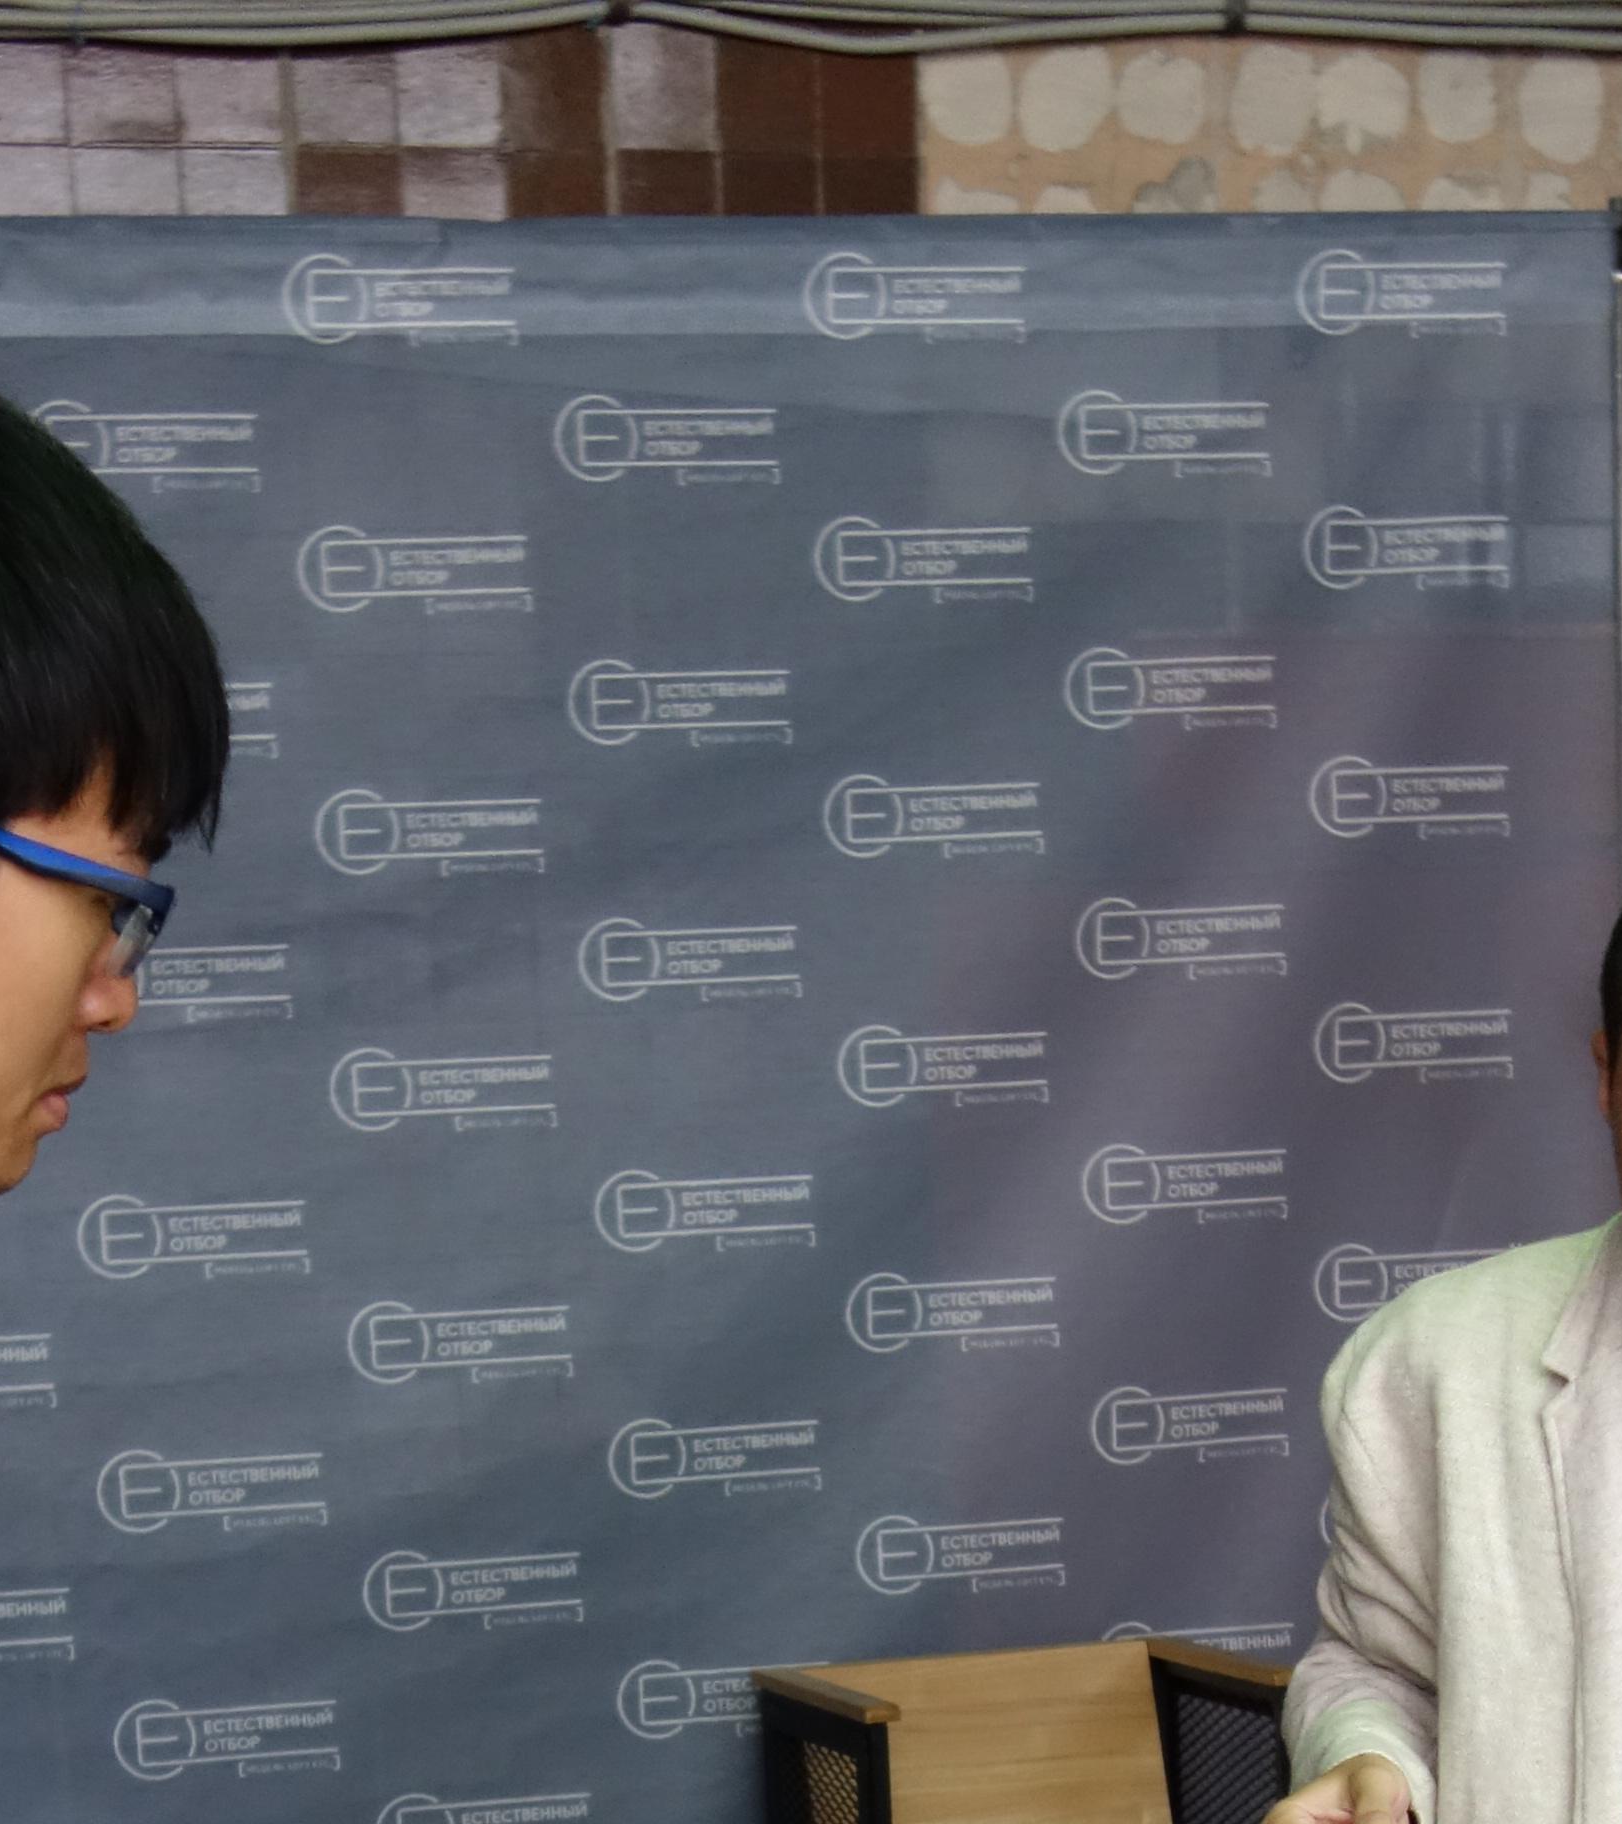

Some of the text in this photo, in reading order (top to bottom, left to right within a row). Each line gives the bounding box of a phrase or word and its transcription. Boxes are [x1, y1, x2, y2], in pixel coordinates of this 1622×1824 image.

[1151, 663, 1272, 685] ЕСТЕСТВЕННЫЙ
[658, 678, 785, 700] ЕСТЕСТВЕННЫЙ
[1151, 689, 1205, 704] ОТБОР
[658, 703, 714, 719] ОТБОР
[1391, 773, 1505, 794] ЕСТЕСТВЕННЫЙ
[911, 790, 1036, 813] ЕСТЕСТВЕННЫЙ
[1391, 798, 1442, 812] ОТБОР
[407, 807, 537, 829] ЕСТЕСТВЕННЫЙ
[912, 816, 967, 832] ОТБОР
[408, 833, 465, 848] ОТБОР
[1158, 912, 1279, 935] ЕСТЕСТВЕННЫЙ
[667, 933, 794, 956] ЕСТЕСТВЕННЫЙ
[1159, 938, 1212, 953] ОТБОР
[150, 953, 284, 976] ЕСТЕСТВЕННЫЙ
[668, 959, 724, 975] ОТБОР
[151, 980, 210, 996] ОТБОР
[1393, 1017, 1507, 1040] ЕСТЕСТВЕННЫЙ
[923, 1040, 1044, 1063] ЕСТЕСТВЕННЫЙ
[1393, 1042, 1443, 1057] ОТБОР
[420, 1063, 549, 1086] ЕСТЕСТВЕННЫЙ
[924, 1065, 977, 1081] ОТБОР
[421, 1089, 478, 1105] ОТБОР
[1166, 1157, 1284, 1180] ЕСТЕСТВЕННЫЙ
[683, 1183, 808, 1207] ЕСТЕСТВЕННЫЙ
[1166, 1183, 1218, 1198] ОТБОР
[170, 1209, 301, 1233] ЕСТЕСТВЕННЫЙ
[684, 1209, 739, 1226] ОТБОР
[171, 1236, 229, 1252] ОТБОР
[930, 1285, 1052, 1309] ЕСТЕСТВЕННЫЙ
[437, 1314, 565, 1339] ЕСТЕСТВЕННЫЙ
[931, 1311, 984, 1327] ОТБОР
[438, 1340, 495, 1357] ОТБОР
[1170, 1395, 1284, 1421] ЕСТЕСТВЕННЫЙ
[1171, 1422, 1221, 1439] ОТБОР
[693, 1428, 815, 1454] ЕСТЕСТВЕННЫЙ
[694, 1455, 747, 1472] ОТБОР
[188, 1461, 319, 1487] ЕСТЕСТВЕННЫЙ
[189, 1489, 247, 1506] ОТБОР
[940, 1525, 1060, 1551] ЕСТЕСТВЕННЫЙ
[941, 1552, 993, 1568] ОТБОР
[451, 1560, 576, 1586] ЕСТЕСТВЕННЫЙ
[452, 1587, 507, 1604] ОТБОР
[703, 1696, 756, 1713] ОТБОР
[204, 1707, 333, 1735] ЕСТЕСТВЕННЫЙ
[205, 1736, 262, 1753] ОТБОР
